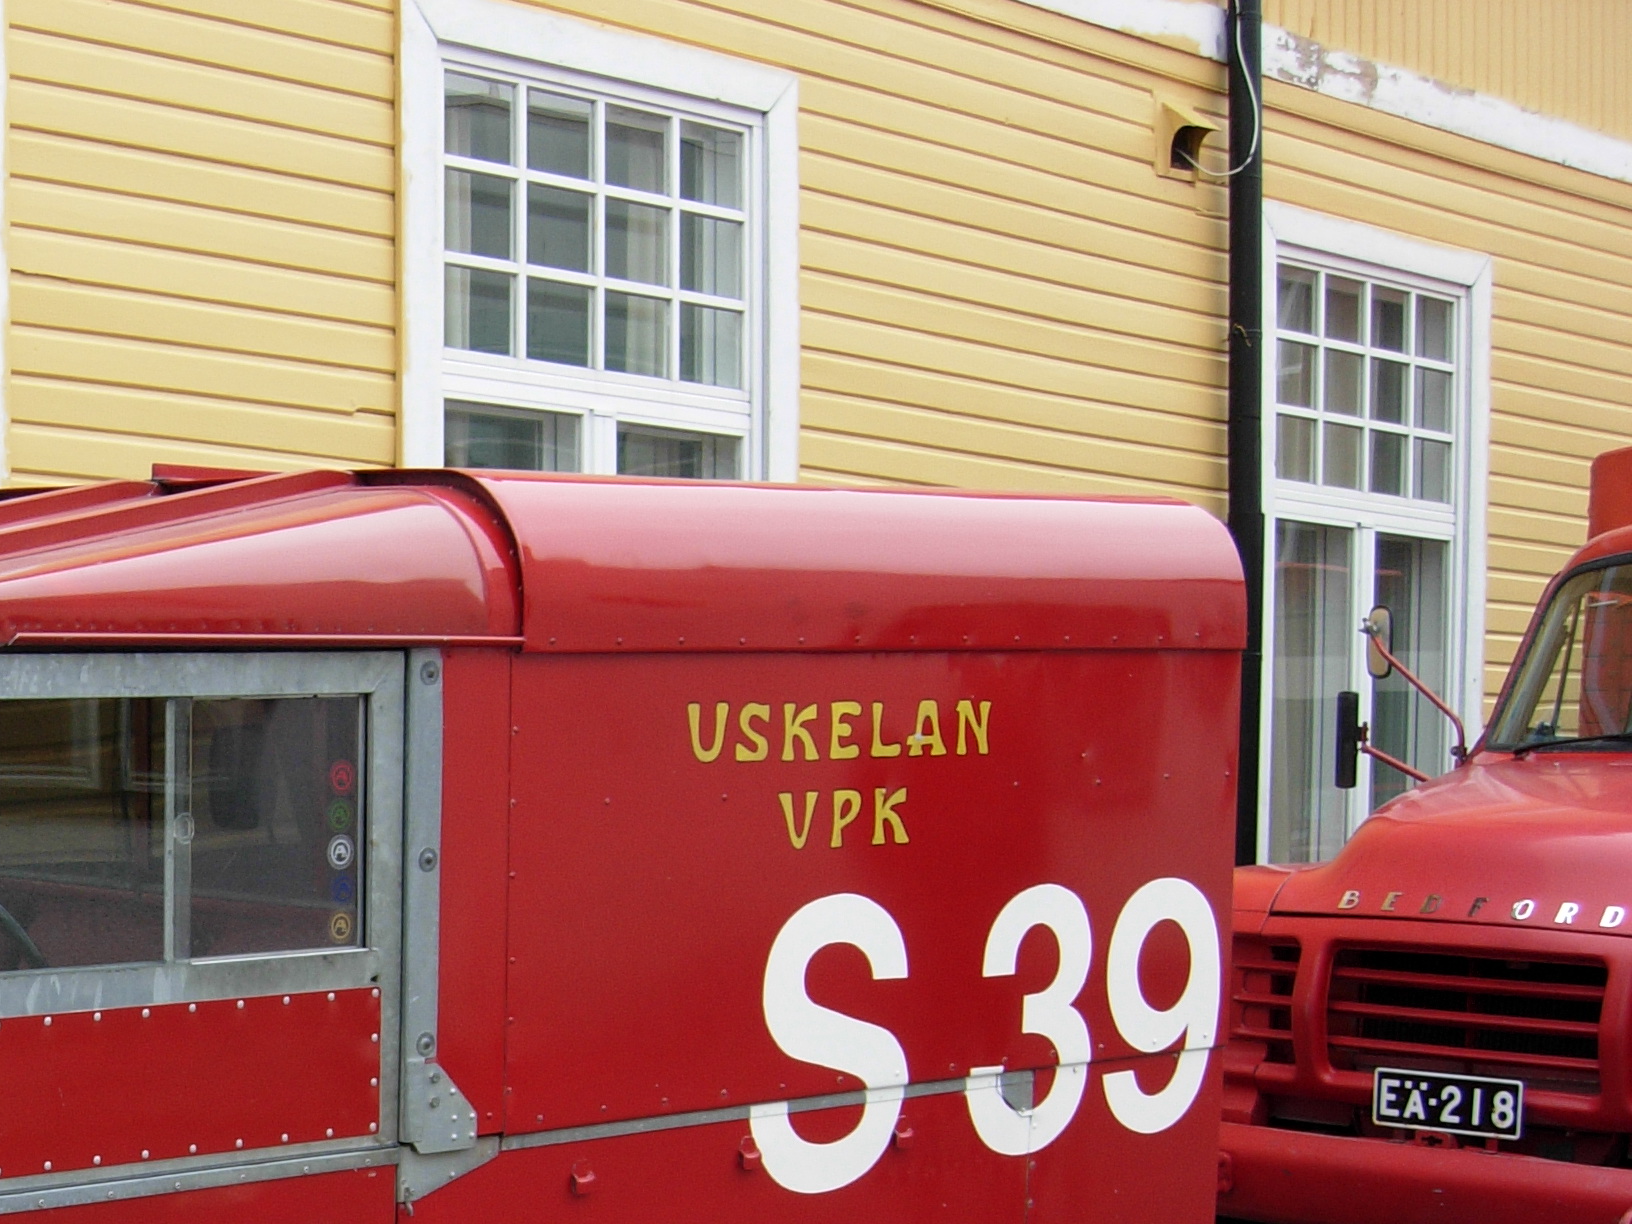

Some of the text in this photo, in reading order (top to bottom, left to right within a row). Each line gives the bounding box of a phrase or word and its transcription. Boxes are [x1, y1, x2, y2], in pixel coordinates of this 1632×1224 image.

[686, 698, 992, 764] USKELAN
[777, 786, 911, 851] VPK
[1336, 888, 1626, 930] BEDFORD
[748, 876, 1222, 1194] S 39
[1377, 1076, 1516, 1130] EÄ-218
